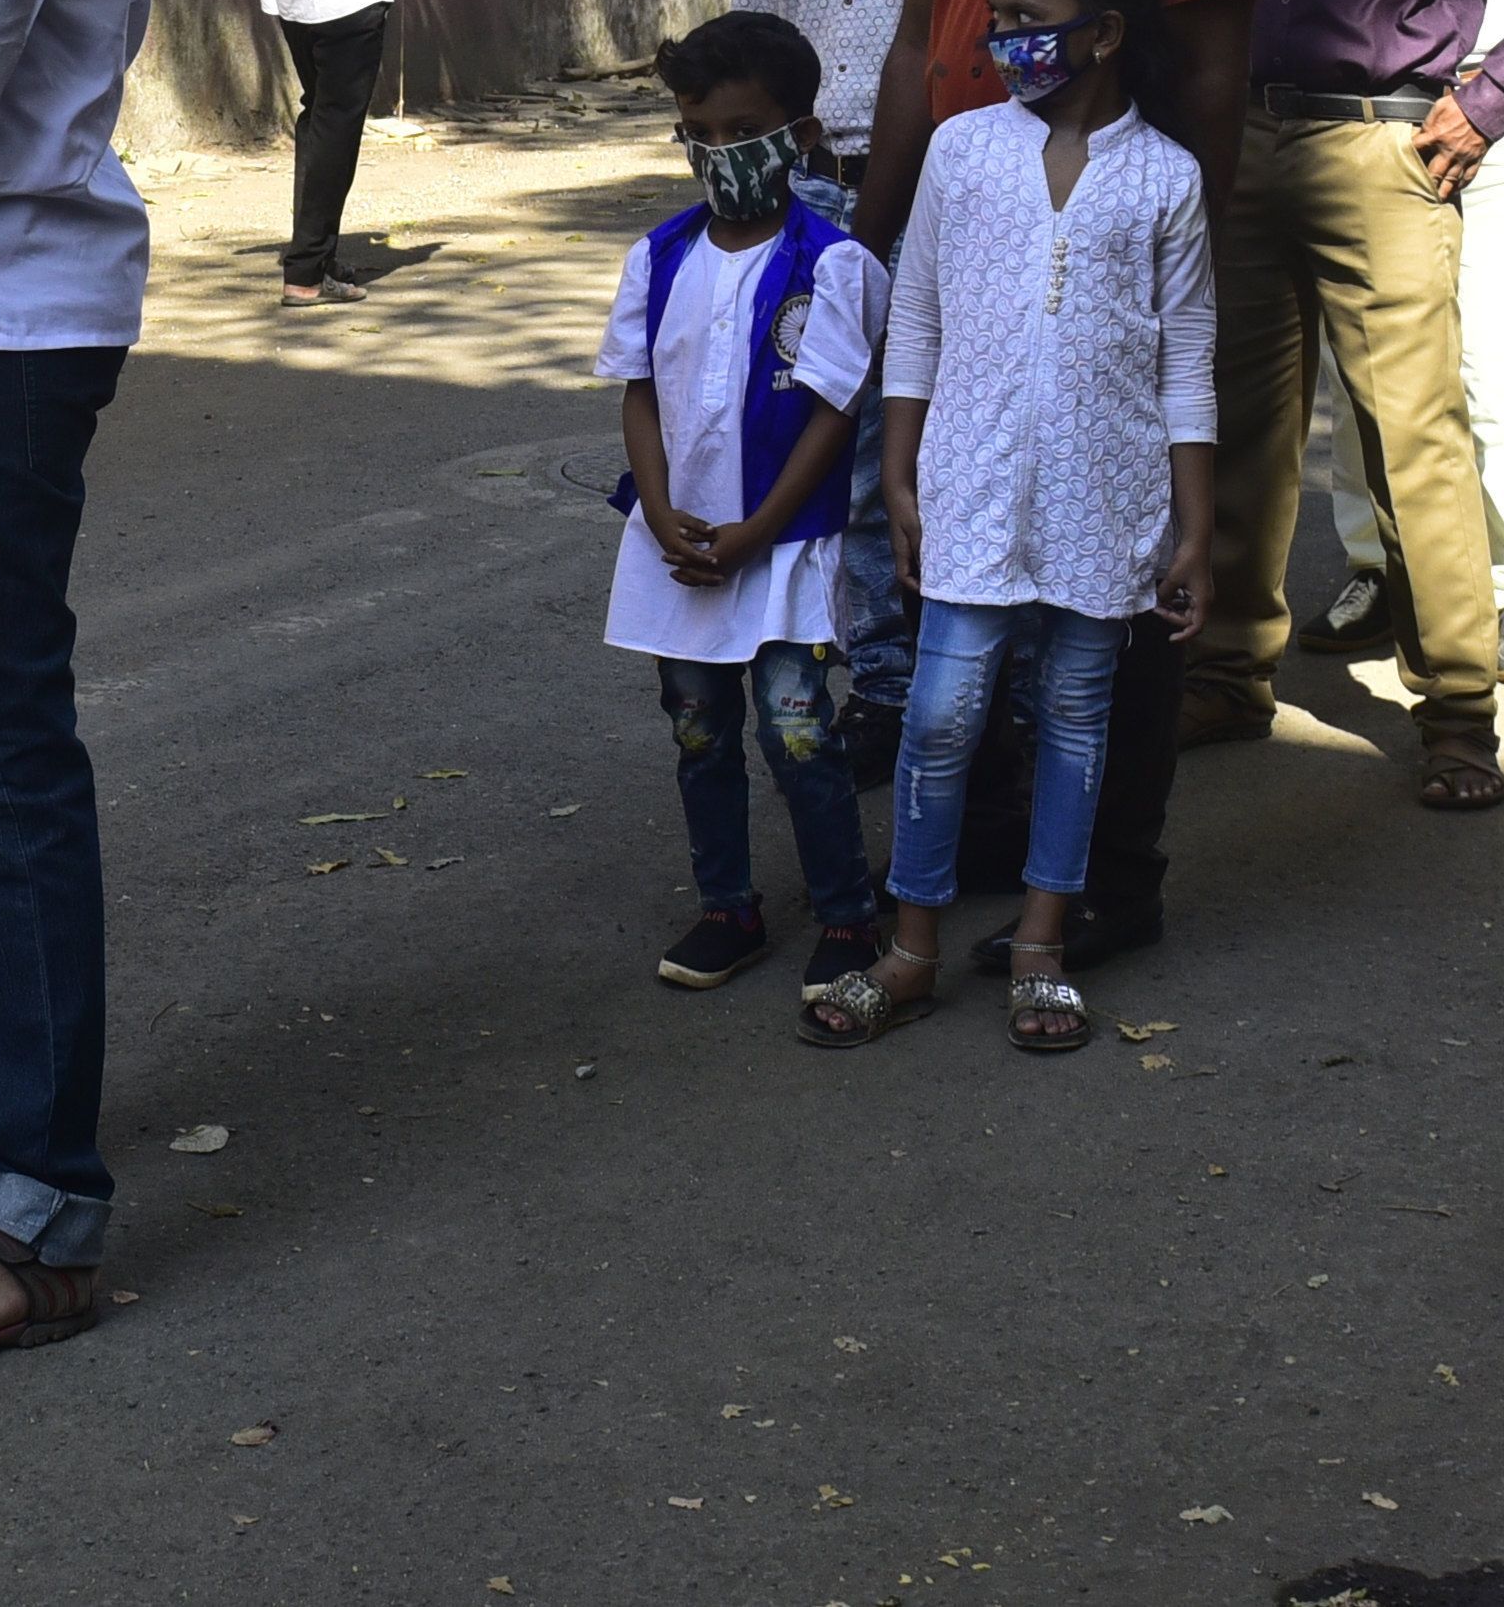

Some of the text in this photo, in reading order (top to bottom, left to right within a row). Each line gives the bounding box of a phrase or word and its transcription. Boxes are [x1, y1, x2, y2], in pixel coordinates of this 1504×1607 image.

[772, 366, 796, 391] JA
[704, 911, 728, 924] AIR
[826, 927, 853, 941] AIR
